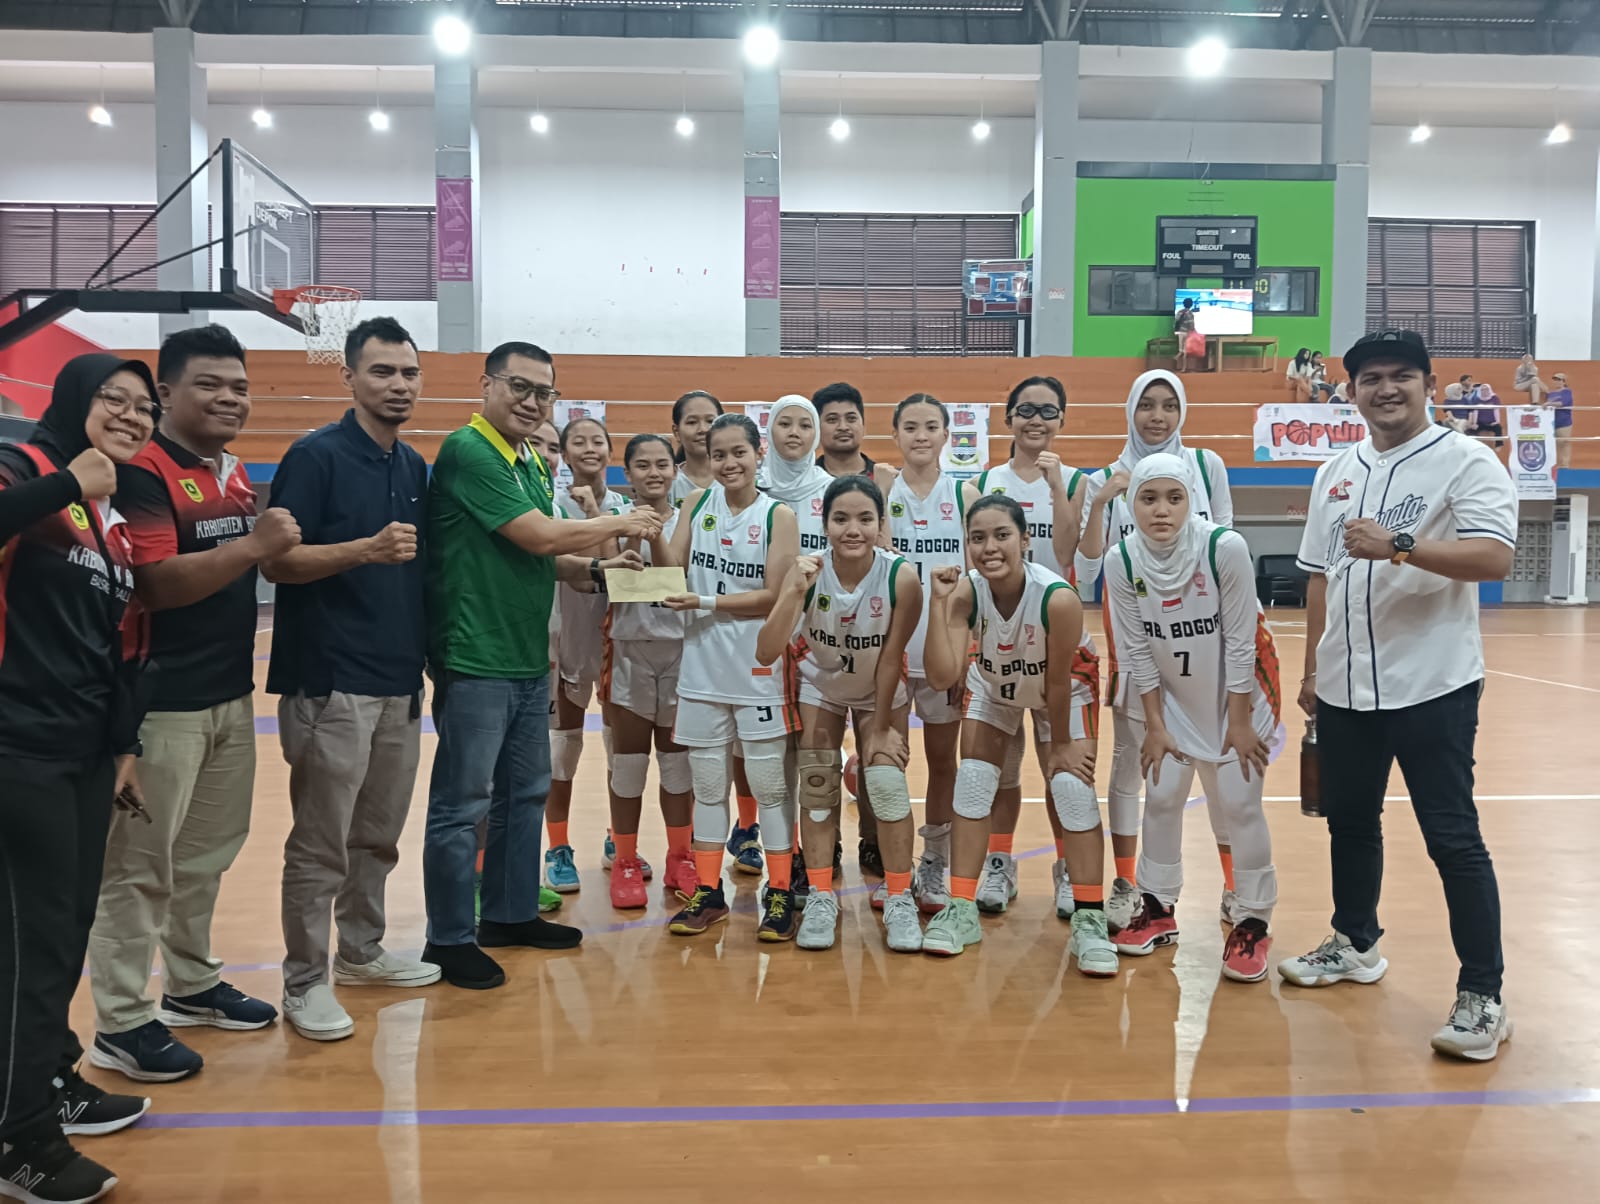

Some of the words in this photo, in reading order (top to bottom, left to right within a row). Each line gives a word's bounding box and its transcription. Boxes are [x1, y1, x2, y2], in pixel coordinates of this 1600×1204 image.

[801, 534, 828, 550] GOR
[892, 538, 912, 553] AB.
[915, 538, 960, 553] BOGOR
[691, 550, 718, 570] KAB.
[1143, 621, 1167, 640] AB.
[1170, 613, 1220, 639] BOGOR
[809, 627, 841, 649] KAB.
[1173, 651, 1192, 677] 7
